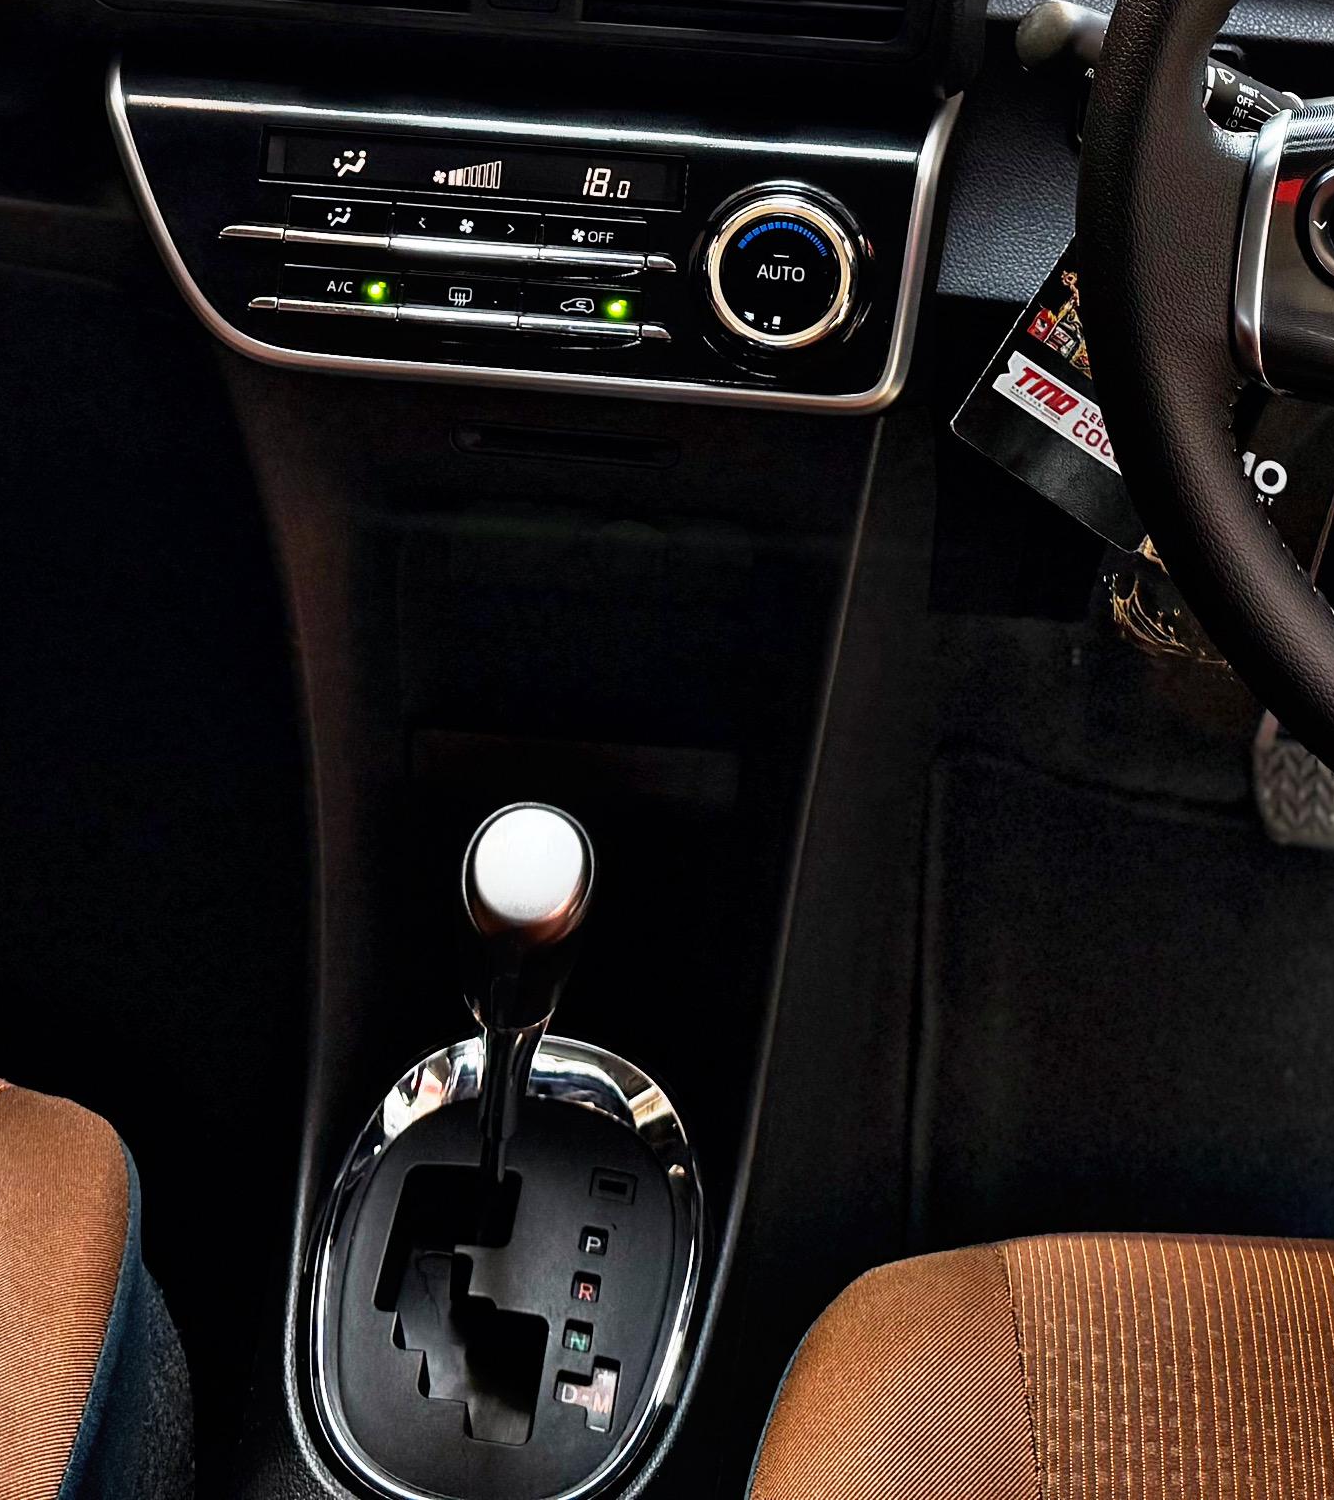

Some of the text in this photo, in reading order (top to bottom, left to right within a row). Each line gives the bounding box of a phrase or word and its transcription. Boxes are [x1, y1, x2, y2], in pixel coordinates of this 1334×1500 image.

[1236, 94, 1255, 108] OFF
[1232, 106, 1249, 120] INT
[1225, 117, 1238, 128] LO
[582, 167, 631, 199] 18.0
[587, 230, 615, 244] OFF
[756, 263, 806, 282] AUTO
[326, 280, 354, 294] A/C
[585, 1235, 602, 1252] P
[578, 1282, 595, 1301] R
[570, 1331, 590, 1353] N
[561, 1384, 610, 1414] D M
